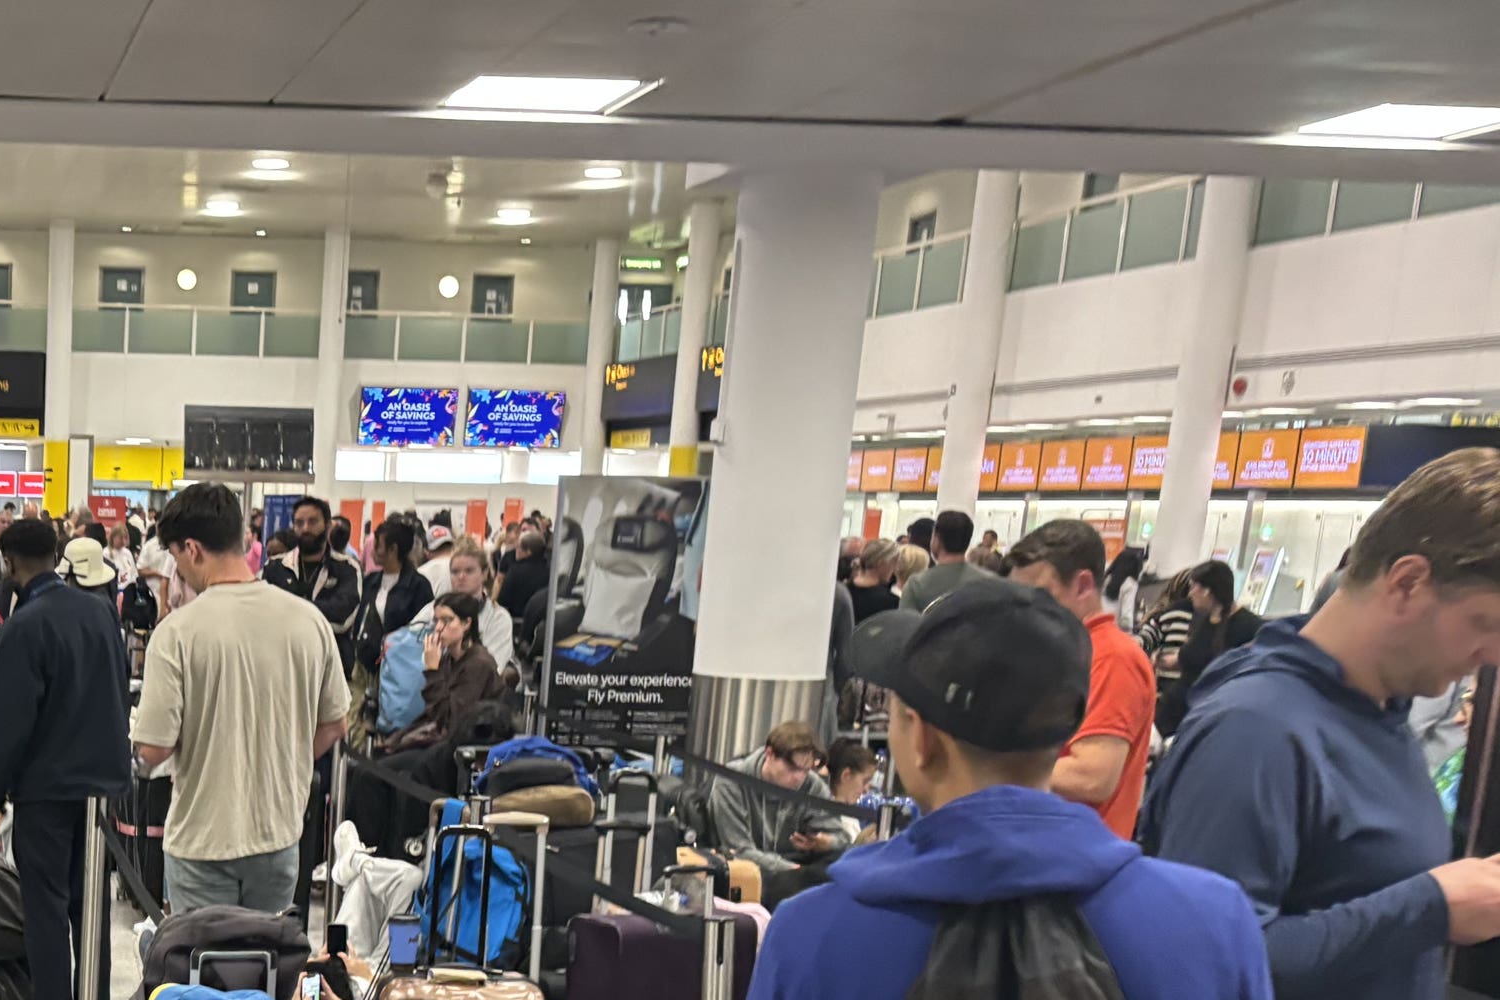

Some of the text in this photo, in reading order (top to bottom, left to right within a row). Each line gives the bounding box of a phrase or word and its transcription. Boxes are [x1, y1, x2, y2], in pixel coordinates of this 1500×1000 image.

[387, 402, 431, 412] AN OASIS
[494, 403, 538, 413] AN OASIS
[381, 411, 435, 420] OF SAVINGS
[488, 412, 542, 421] OF SAVINGS
[555, 671, 600, 686] Elevate
[601, 673, 629, 688] your
[587, 689, 664, 705] Fly Premium.
